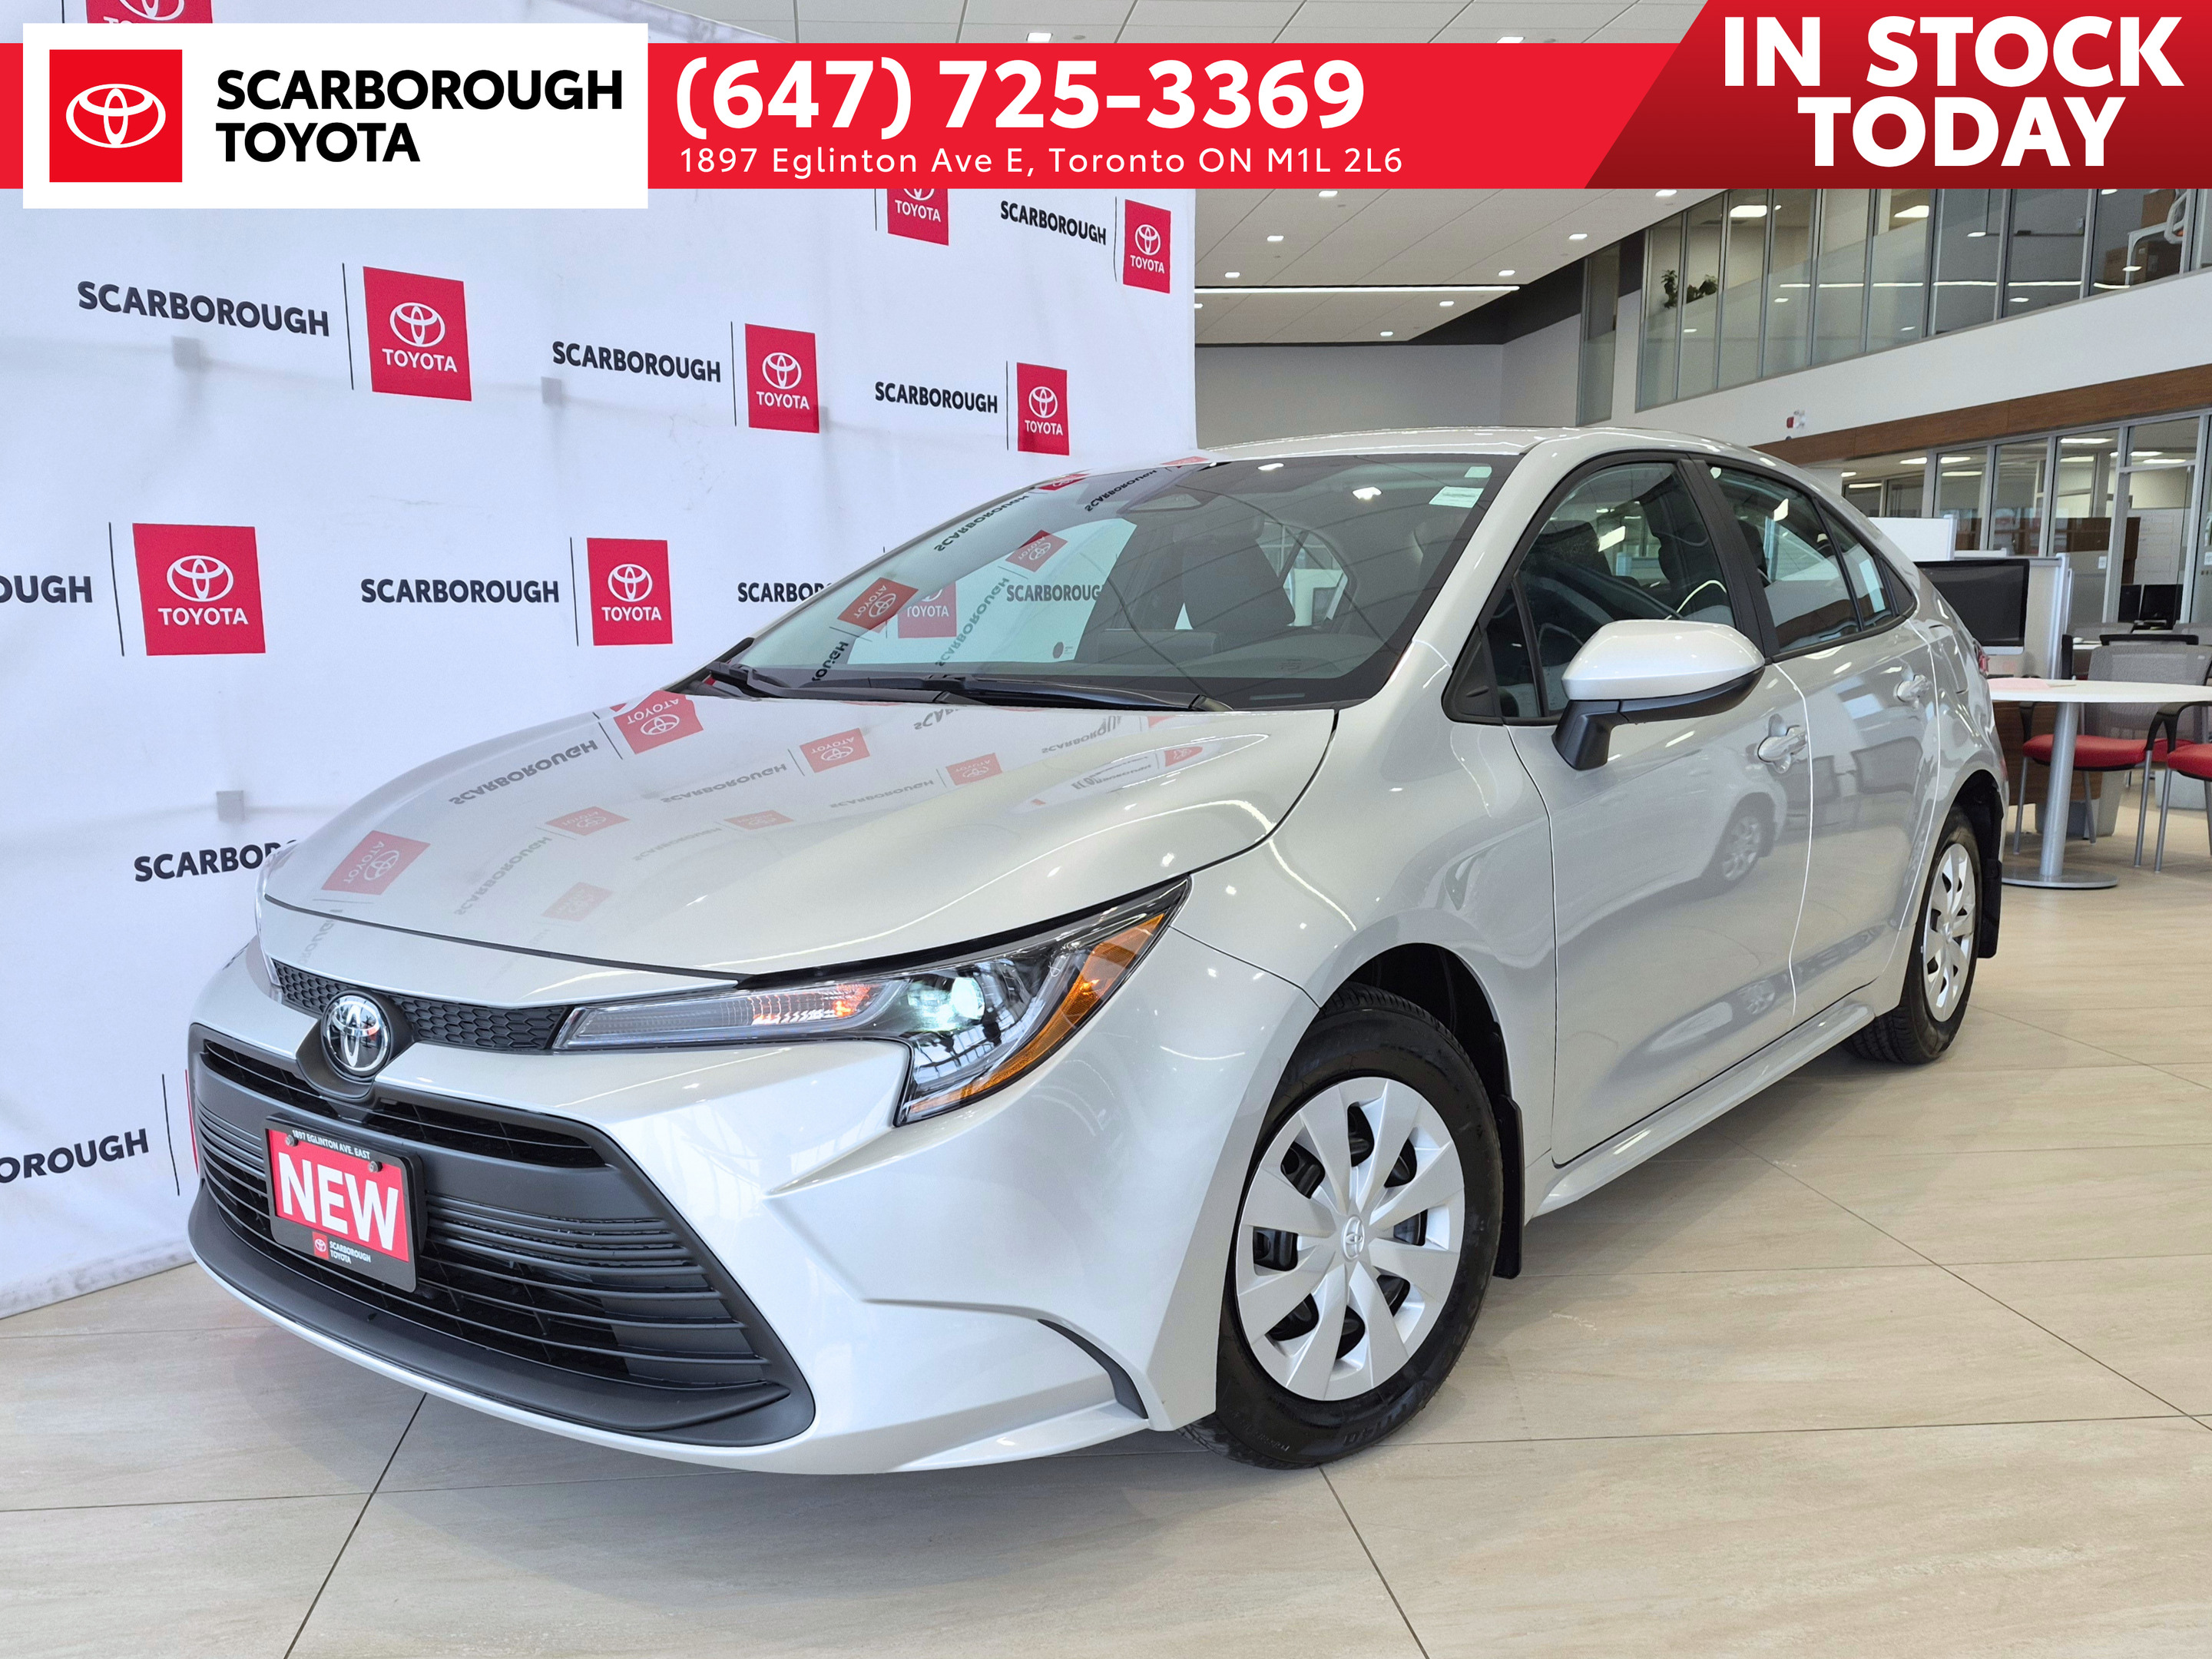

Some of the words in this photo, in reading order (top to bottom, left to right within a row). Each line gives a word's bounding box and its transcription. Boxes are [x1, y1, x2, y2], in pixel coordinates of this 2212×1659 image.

[894, 199, 941, 223] TOYOTA
[1001, 200, 1107, 246] SCARBOROUGH
[1130, 254, 1165, 274] TOYOTA
[78, 281, 329, 337] SCARBOROUGH
[382, 348, 458, 373] TOYOTA
[552, 341, 721, 382] SCARBOROUGH
[756, 392, 810, 410] TOYOTA
[875, 381, 998, 415] SCARBOROUGH
[1024, 419, 1063, 436] TOYOTA
[361, 578, 559, 603] SCARBOROUGH
[157, 607, 249, 626] TOYOTA
[601, 606, 662, 622] TOYOTA
[906, 605, 950, 618] TOYOTA
[292, 1130, 306, 1141] 1897
[306, 1134, 338, 1151] EGLINTON
[354, 1147, 370, 1160] EAST
[278, 1151, 398, 1250] NEW
[329, 1240, 371, 1263] SCARBOROUGH
[330, 1250, 352, 1264] TOYOTA
